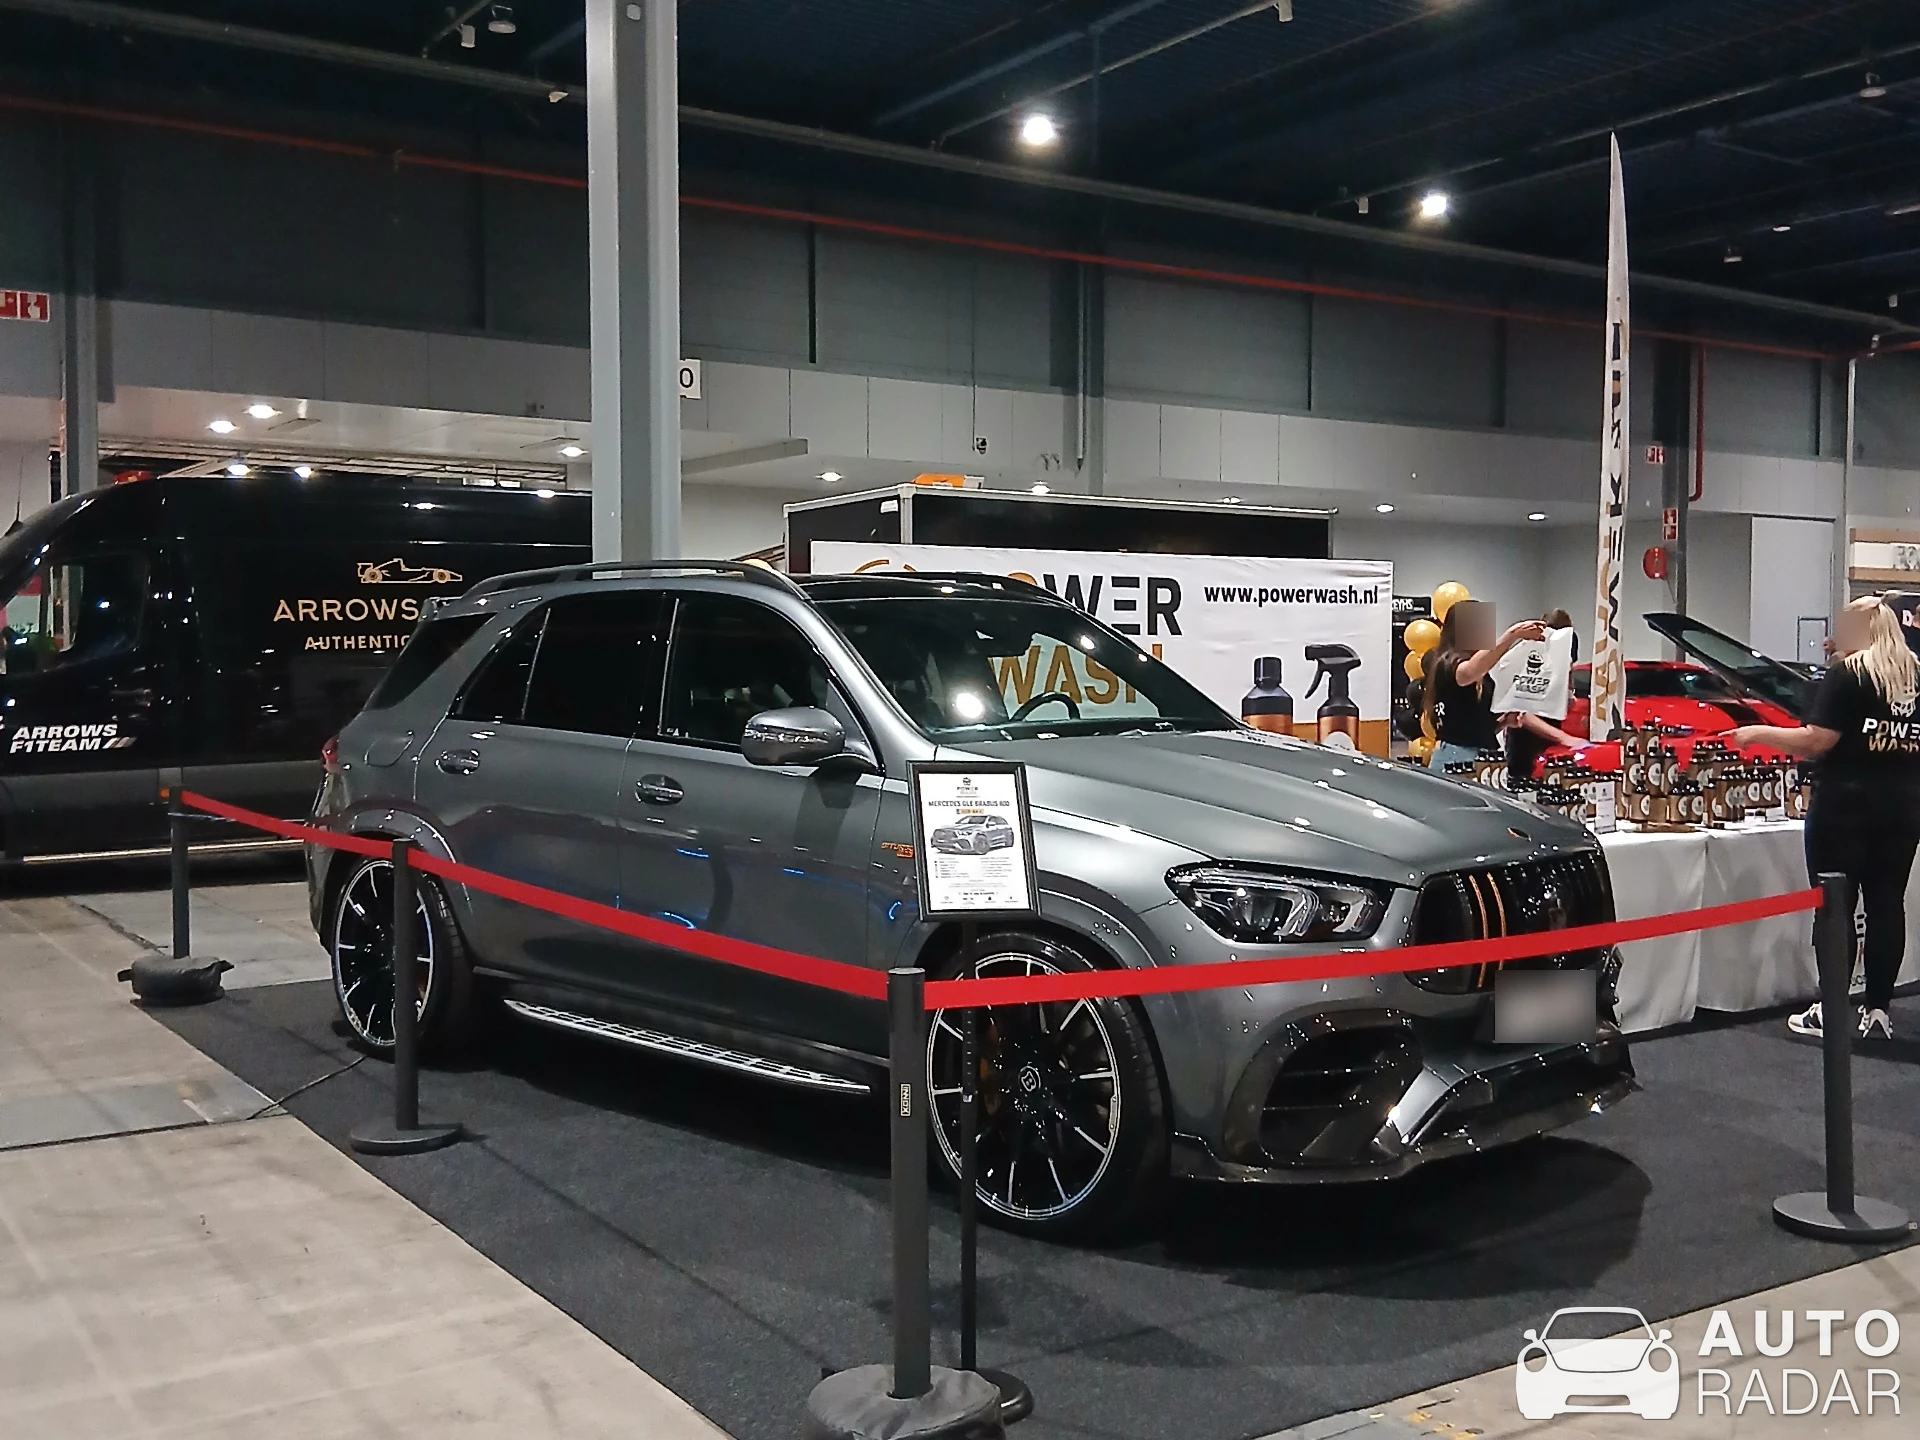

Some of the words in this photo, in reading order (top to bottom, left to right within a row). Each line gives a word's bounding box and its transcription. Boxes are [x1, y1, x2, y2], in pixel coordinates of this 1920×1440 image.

[1204, 584, 1379, 608] www.powerwash.nl
[273, 598, 419, 622] ARROWS
[12, 724, 118, 740] ARROWS
[1862, 717, 1920, 740] POWE
[9, 738, 101, 754] F1TEAM
